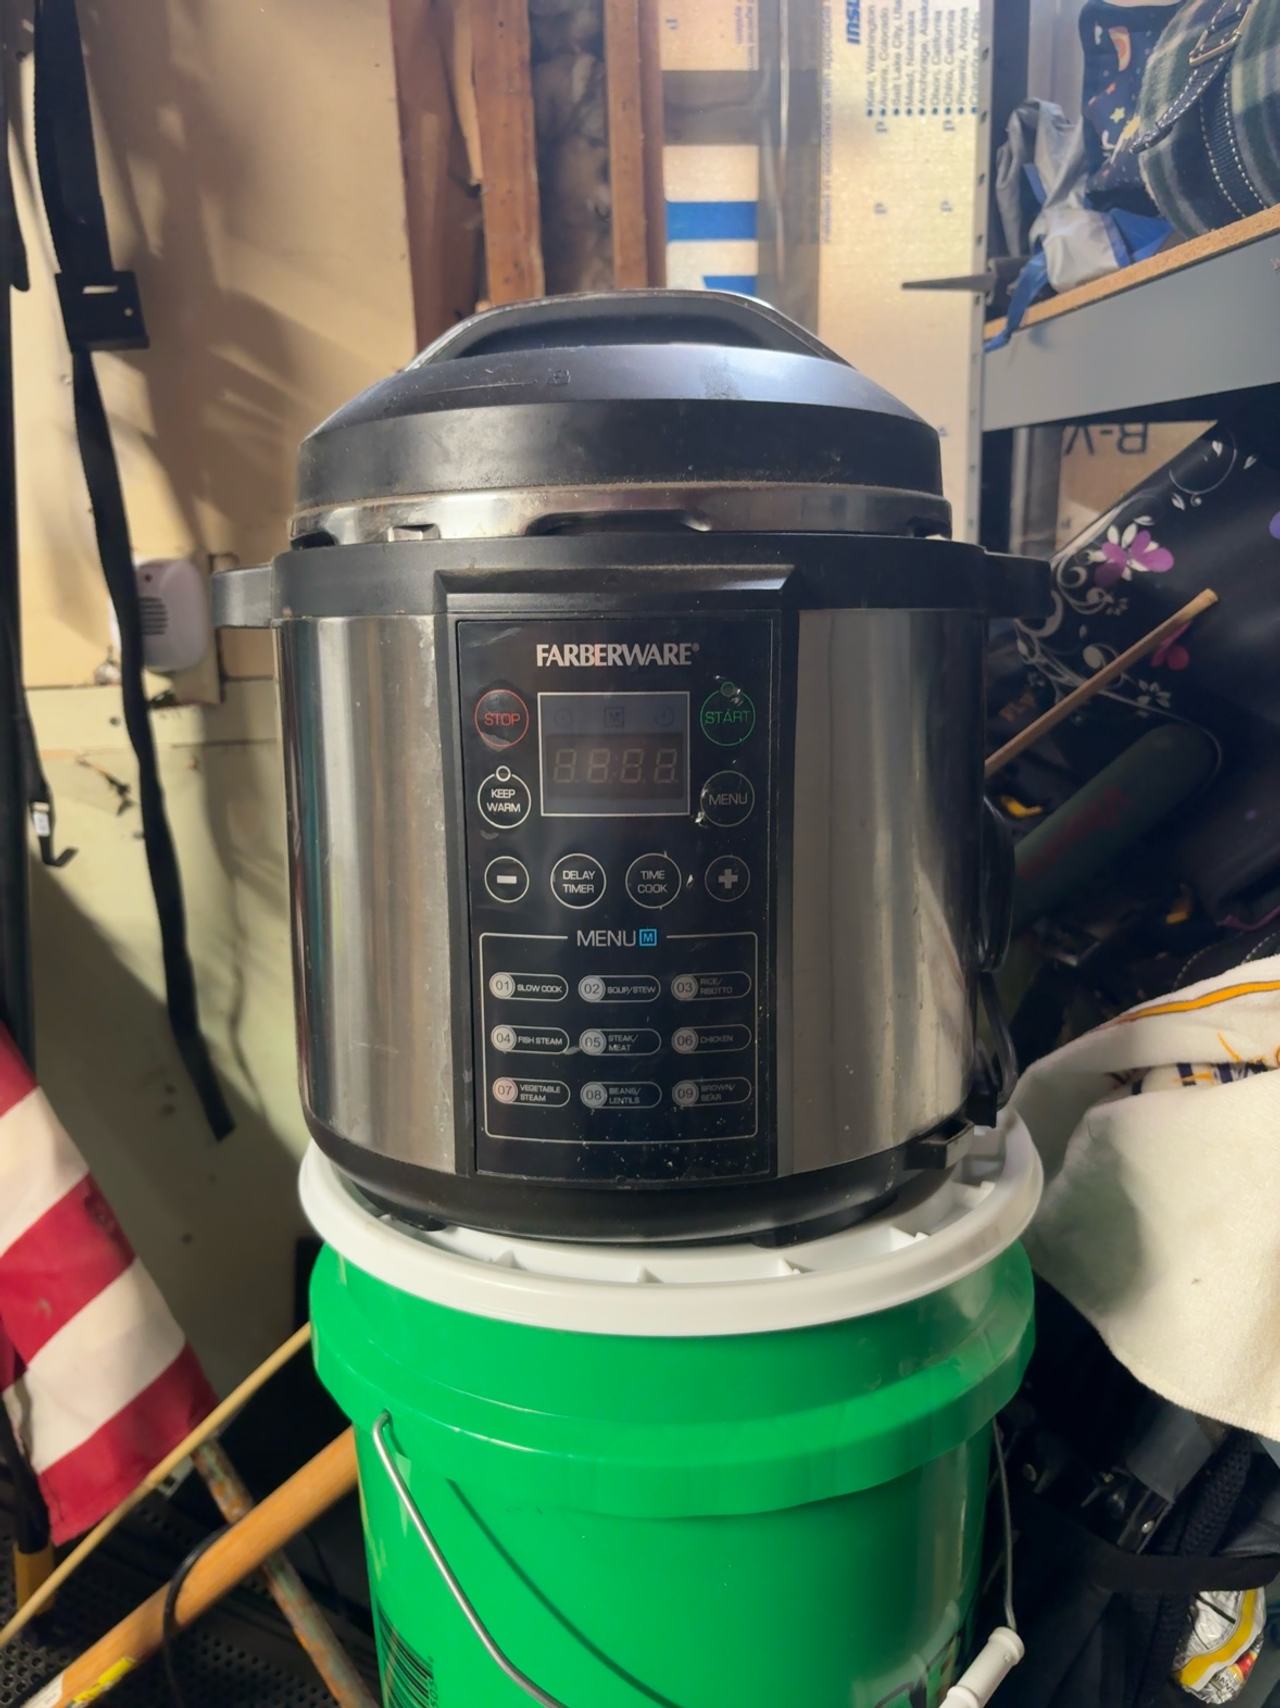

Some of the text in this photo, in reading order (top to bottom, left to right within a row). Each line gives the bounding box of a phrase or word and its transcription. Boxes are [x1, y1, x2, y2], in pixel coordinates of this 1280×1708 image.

[484, 713, 521, 726] STOP
[705, 710, 751, 724] START
[491, 788, 516, 799] KEEP
[708, 793, 748, 806] MENU
[487, 802, 521, 813] WARM
[562, 870, 596, 881] DELAY
[640, 870, 666, 881] TIME
[562, 884, 595, 894] TIMER
[637, 884, 668, 894] COOK
[577, 930, 637, 947] MENU
[495, 980, 563, 993] 01 SLOW COOK
[584, 983, 600, 994] 02
[676, 982, 694, 993] 03
[496, 1033, 563, 1046] 04 FISH STEAM
[584, 1037, 601, 1048] 05
[676, 1034, 735, 1046] 06 CHICKEN
[497, 1085, 512, 1096] 07
[519, 1084, 561, 1094] VEGETABLE
[585, 1089, 602, 1100] 08
[676, 1088, 694, 1099] 09
[520, 1094, 547, 1102] STEAM
[608, 1096, 640, 1104] LENTILS
